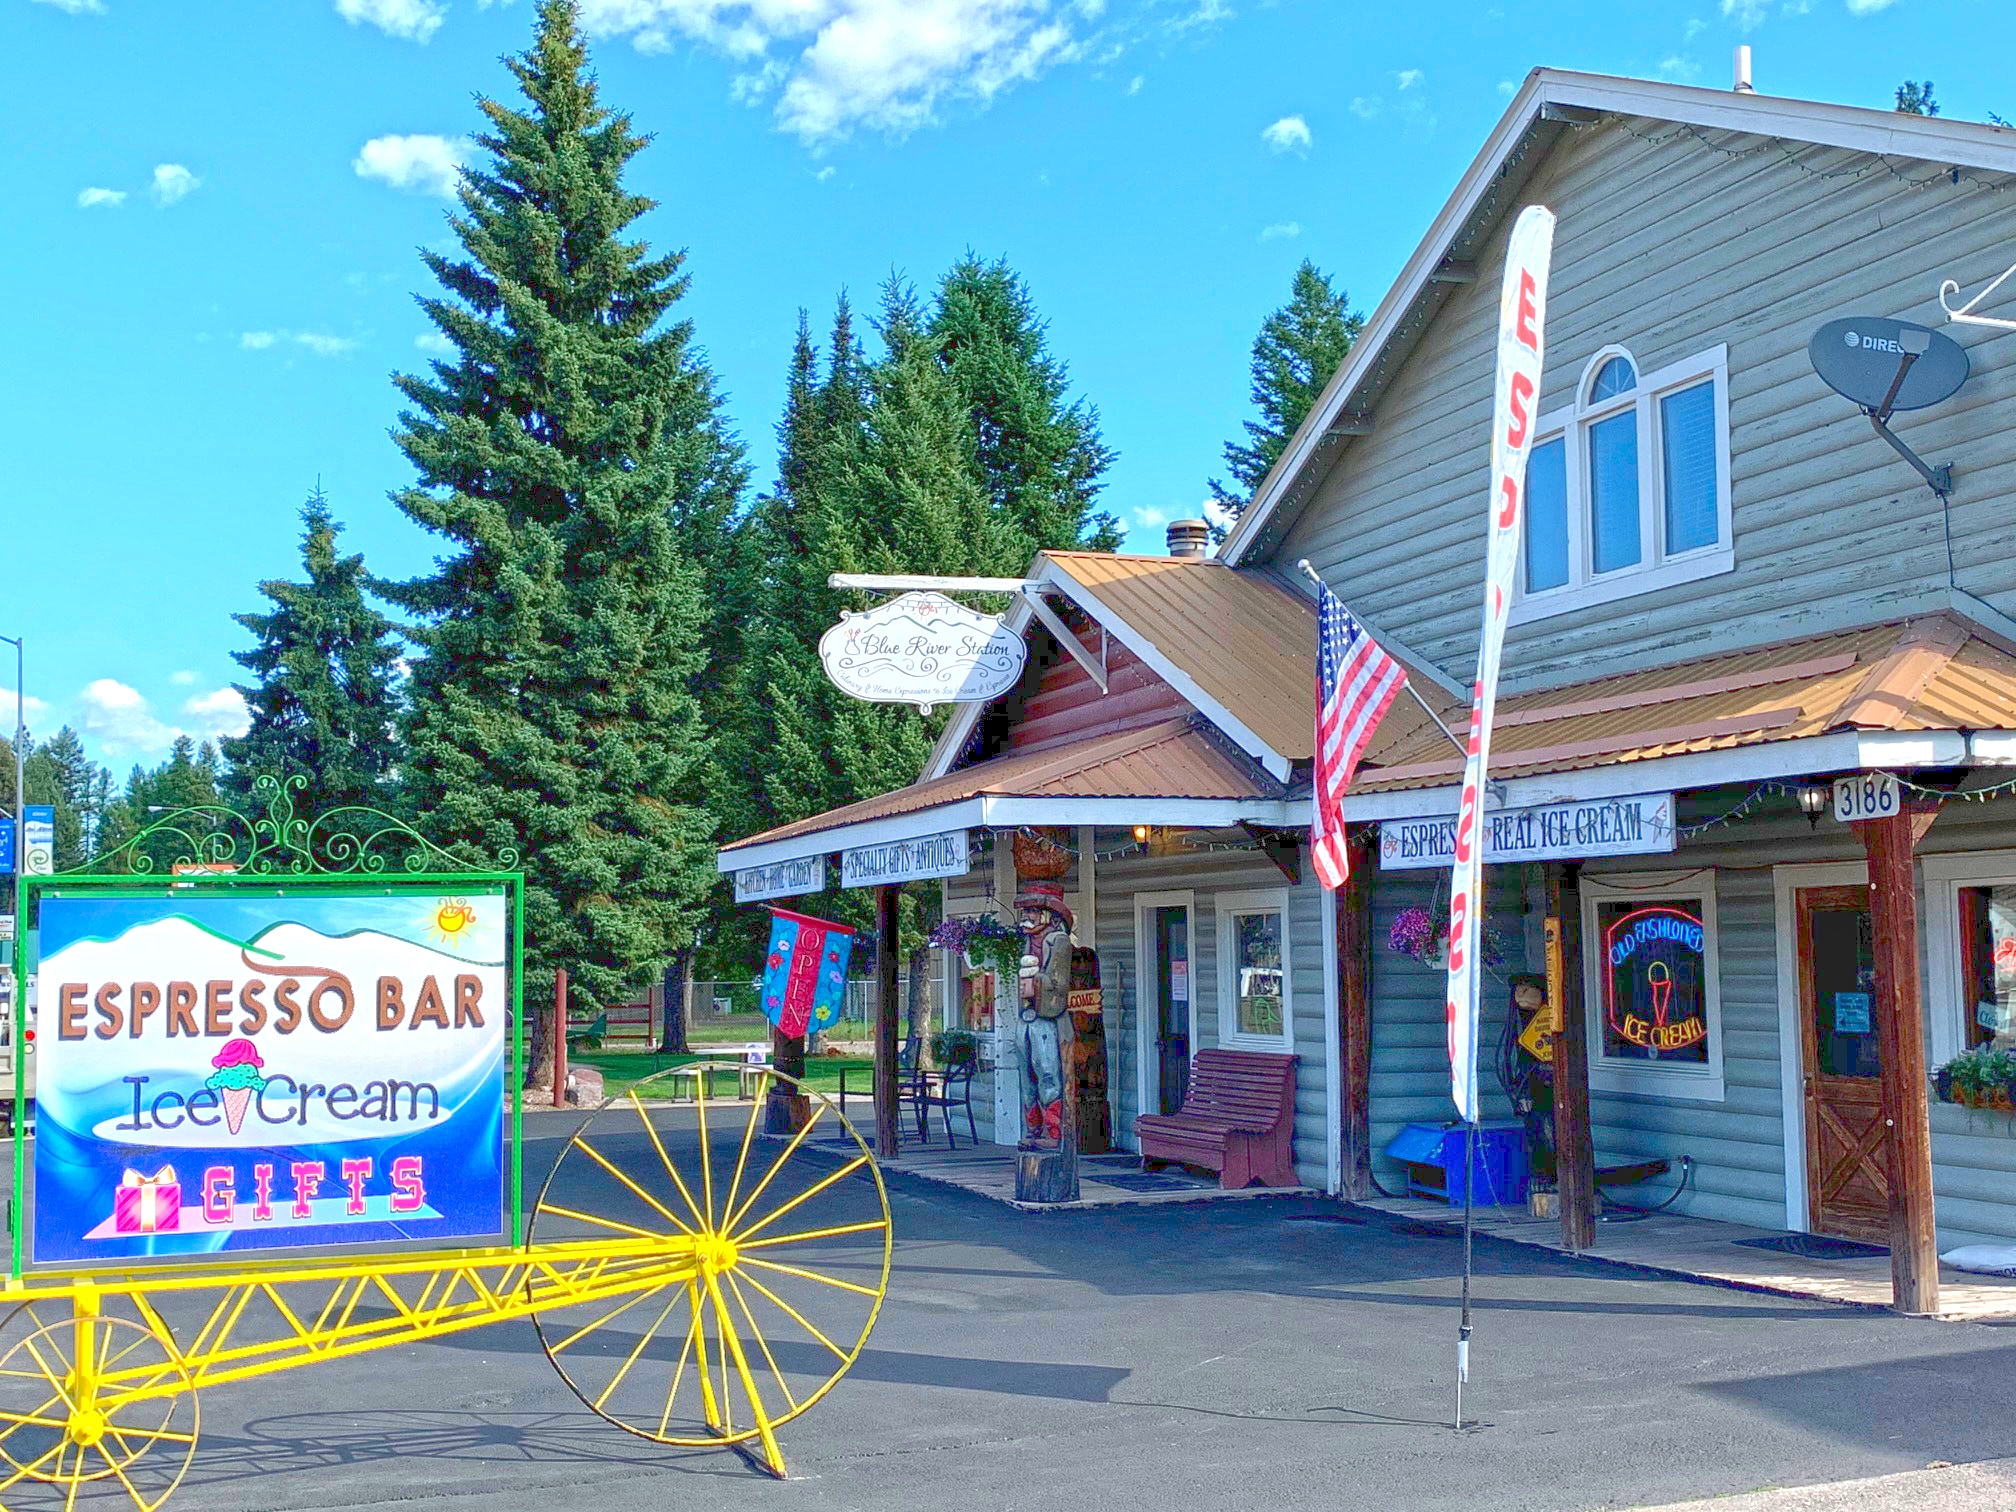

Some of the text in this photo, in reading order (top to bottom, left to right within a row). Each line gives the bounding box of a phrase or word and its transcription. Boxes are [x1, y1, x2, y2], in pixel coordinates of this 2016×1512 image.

[860, 634, 1010, 657] Blue River Station
[1840, 778, 1892, 816] 3186
[1401, 802, 1643, 859] ESPRES REAL ICE CREAM
[849, 836, 955, 880] SPECIALTY GIFTS ANTIQUES
[1610, 918, 1705, 965] OLD FASHIONED
[788, 927, 820, 1028] OPEN
[1065, 992, 1095, 1008] LCOME
[58, 972, 487, 1042] ESPRESSO BAR
[1623, 1013, 1703, 1047] ICE CREAM
[115, 1073, 440, 1132] Ice Cream
[200, 1154, 428, 1225] GIFTS
